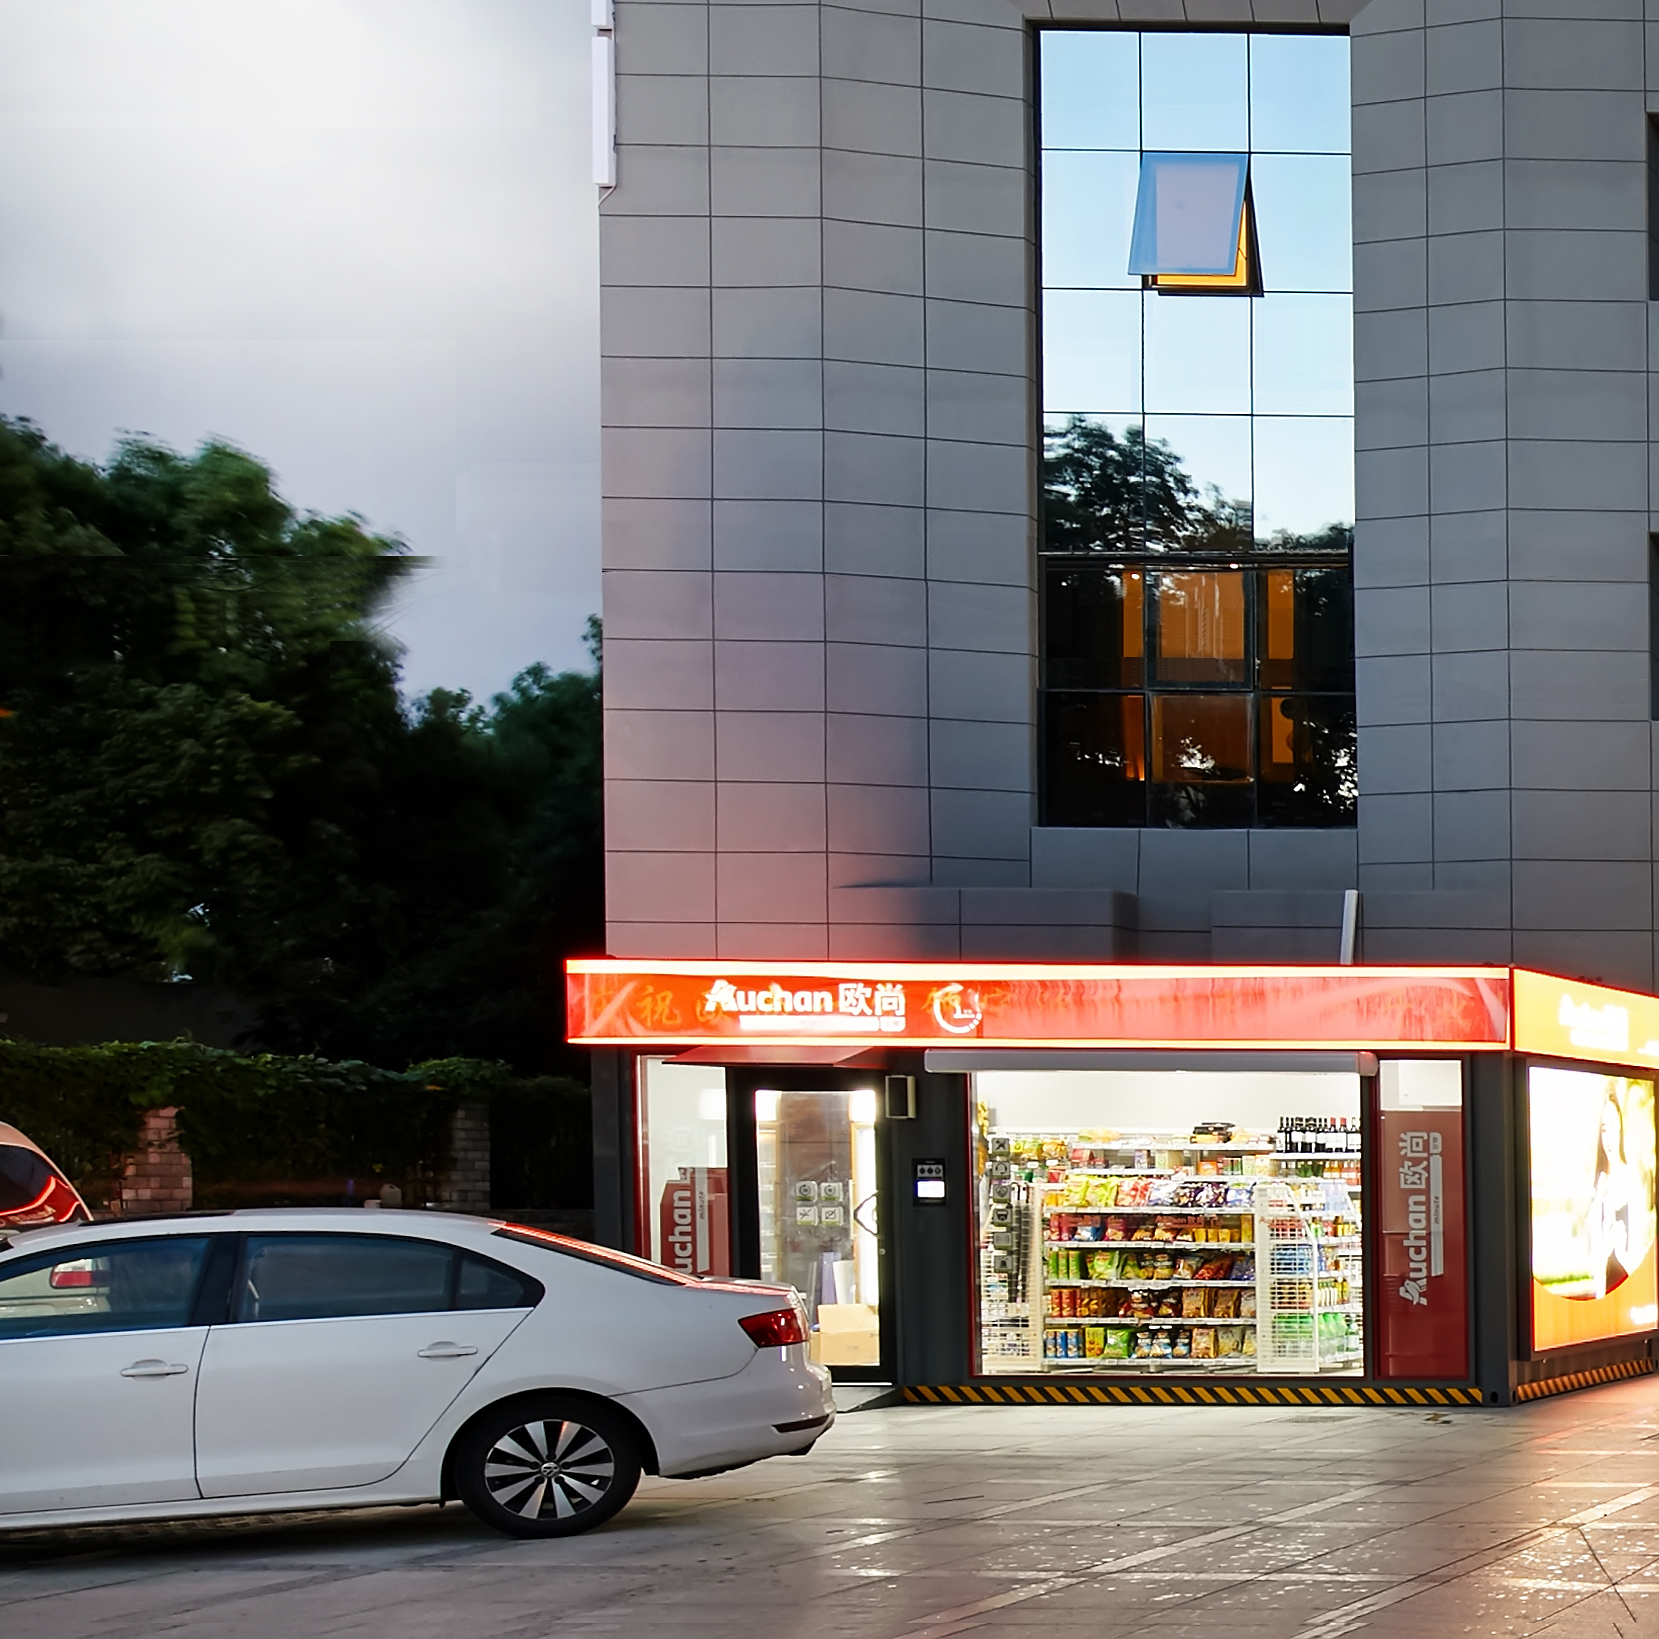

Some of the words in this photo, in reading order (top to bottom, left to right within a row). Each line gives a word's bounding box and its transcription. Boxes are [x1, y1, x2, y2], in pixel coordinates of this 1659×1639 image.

[705, 979, 832, 1013] Auchan
[838, 982, 906, 1016] 欧尚
[1397, 1131, 1429, 1189] 欧尚
[668, 1190, 693, 1275] uchan
[1432, 1195, 1441, 1225] minute
[1398, 1195, 1428, 1306] Auchan
